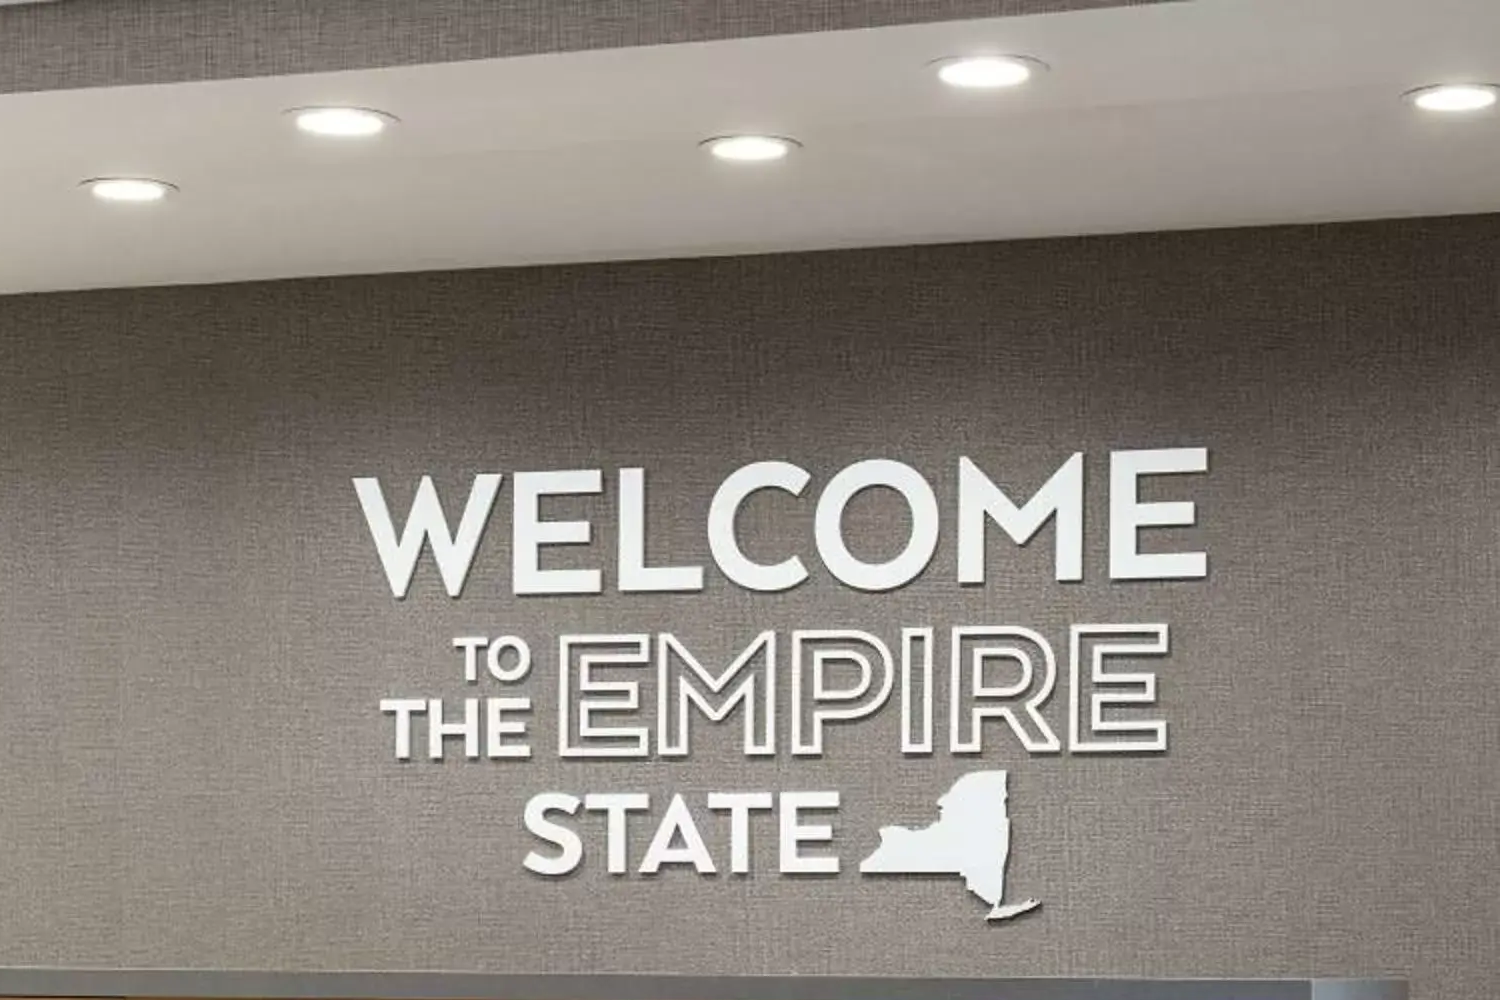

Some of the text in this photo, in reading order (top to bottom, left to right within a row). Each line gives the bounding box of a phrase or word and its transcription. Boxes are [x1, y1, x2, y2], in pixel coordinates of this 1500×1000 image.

[351, 446, 1209, 598] WELCOME
[379, 622, 1171, 760] THE EMPIRE
[452, 635, 533, 683] TO
[522, 791, 841, 877] STATE
